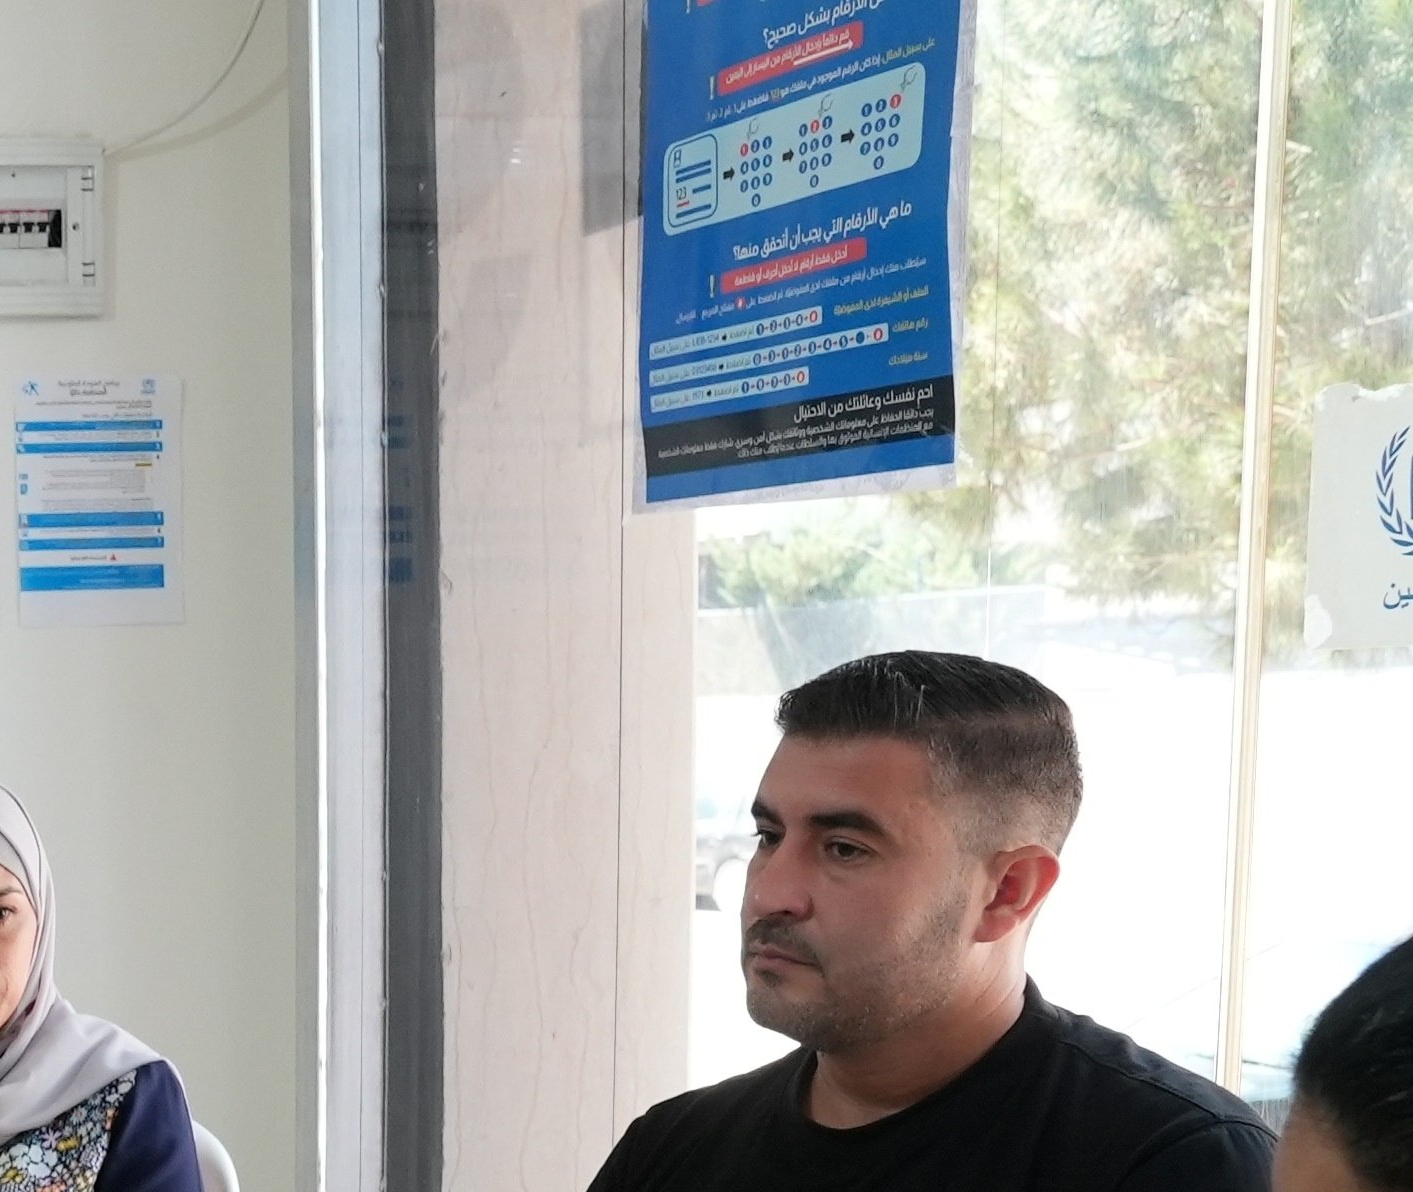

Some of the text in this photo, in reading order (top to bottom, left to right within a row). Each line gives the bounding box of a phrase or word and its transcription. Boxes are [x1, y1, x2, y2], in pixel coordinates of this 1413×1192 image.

[797, 5, 830, 34] بشكل
[762, 19, 796, 49] صحيح؟
[879, 204, 899, 229] هي
[900, 198, 912, 216] ما
[823, 217, 842, 242] التي
[843, 206, 878, 236] الأرقام
[789, 223, 800, 250] أن
[801, 226, 821, 245] يجب
[793, 383, 933, 422] احم نفسك وعائلتك من الاحتيال
